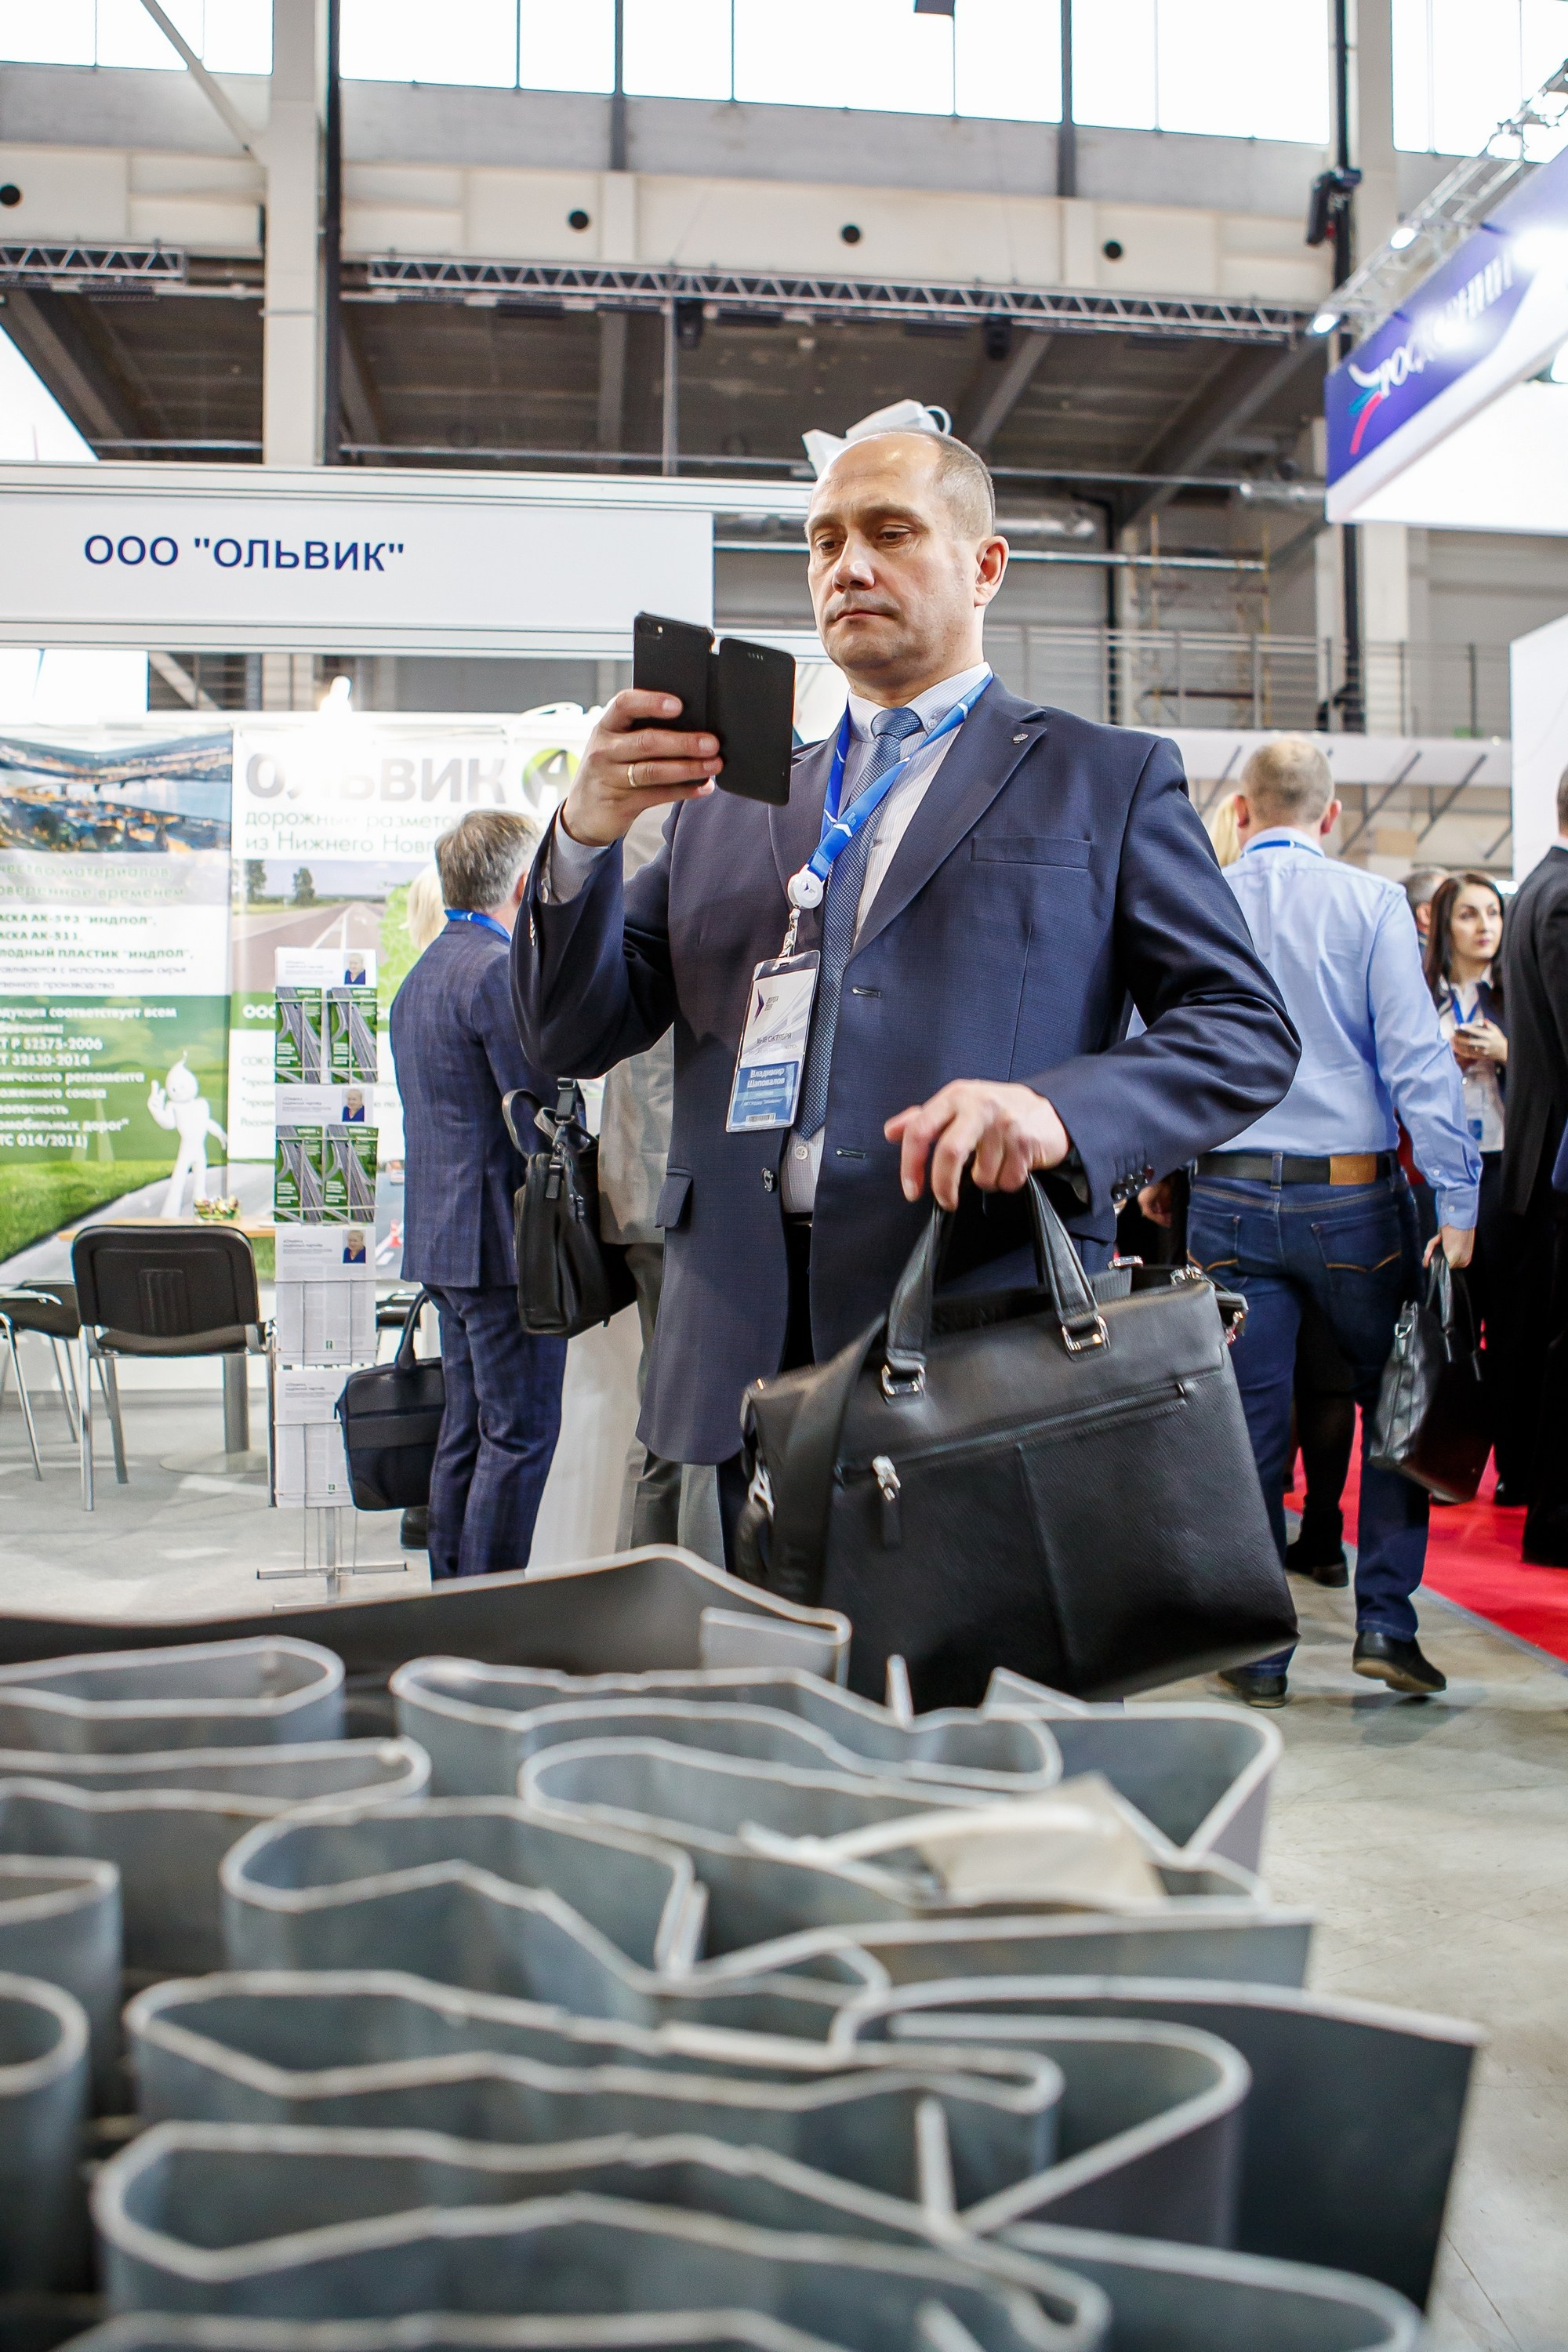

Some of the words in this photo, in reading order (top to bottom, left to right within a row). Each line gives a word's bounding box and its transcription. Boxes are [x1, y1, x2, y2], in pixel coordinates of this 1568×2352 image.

[84, 535, 180, 566] ООО
[194, 537, 405, 572] "ОЛЬВИК"
[245, 753, 507, 804] ОЬВИК
[245, 837, 270, 851] из
[278, 832, 374, 853] Нижнего
[383, 834, 435, 854] Новг
[58, 948, 119, 958] ПЛАСТИК
[750, 1067, 786, 1079] Владимир
[746, 1077, 786, 1089] Шаповалов
